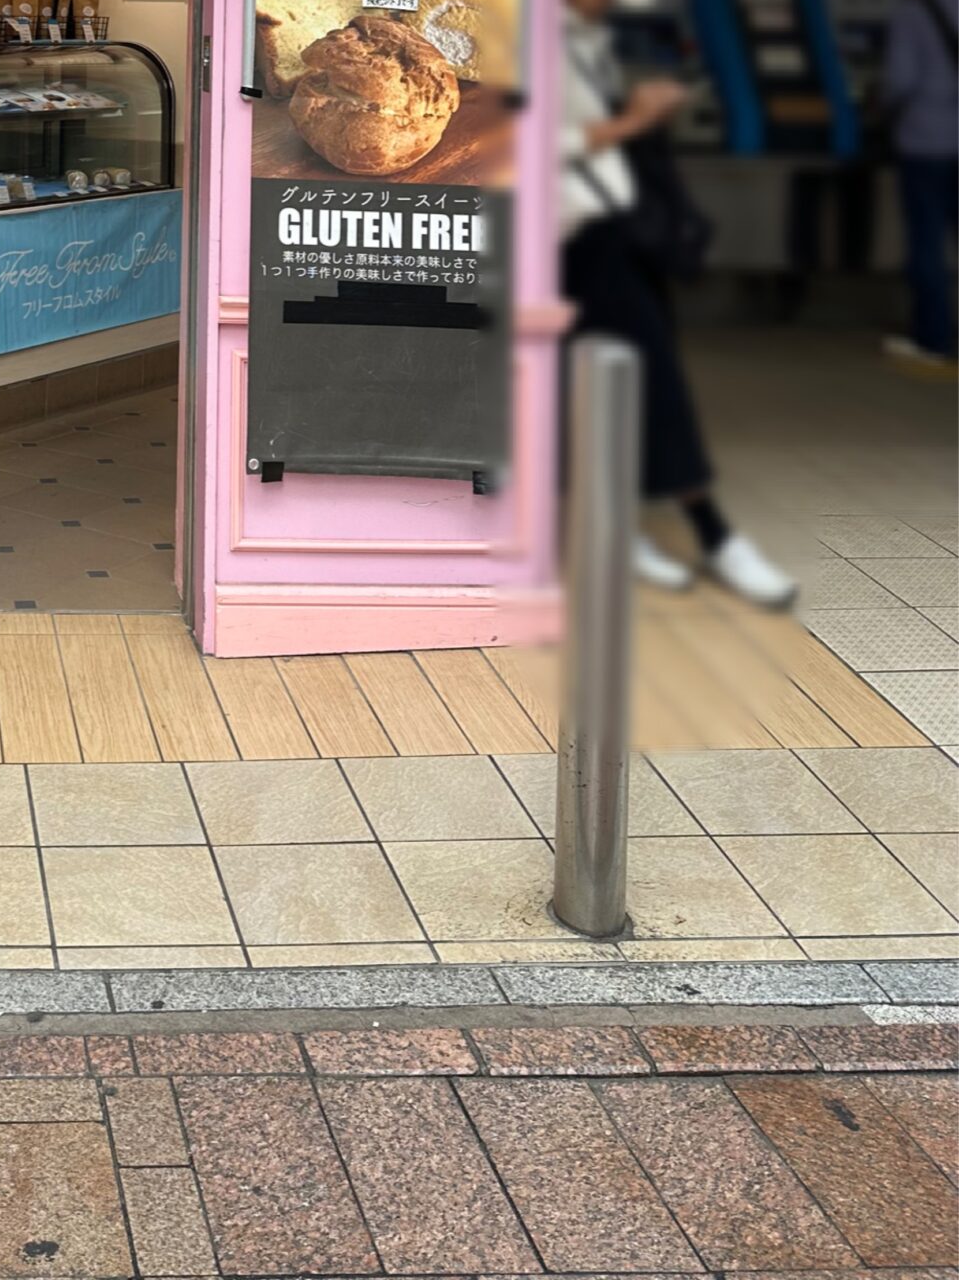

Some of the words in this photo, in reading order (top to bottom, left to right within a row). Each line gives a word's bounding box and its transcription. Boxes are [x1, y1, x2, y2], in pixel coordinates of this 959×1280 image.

[281, 186, 484, 211] グルテンフリースイーツ
[278, 207, 403, 249] GLUTEN
[261, 264, 482, 285] 1つ1つ手作りの美味しさで作っており
[22, 284, 122, 319] フリーフロムスタイル
